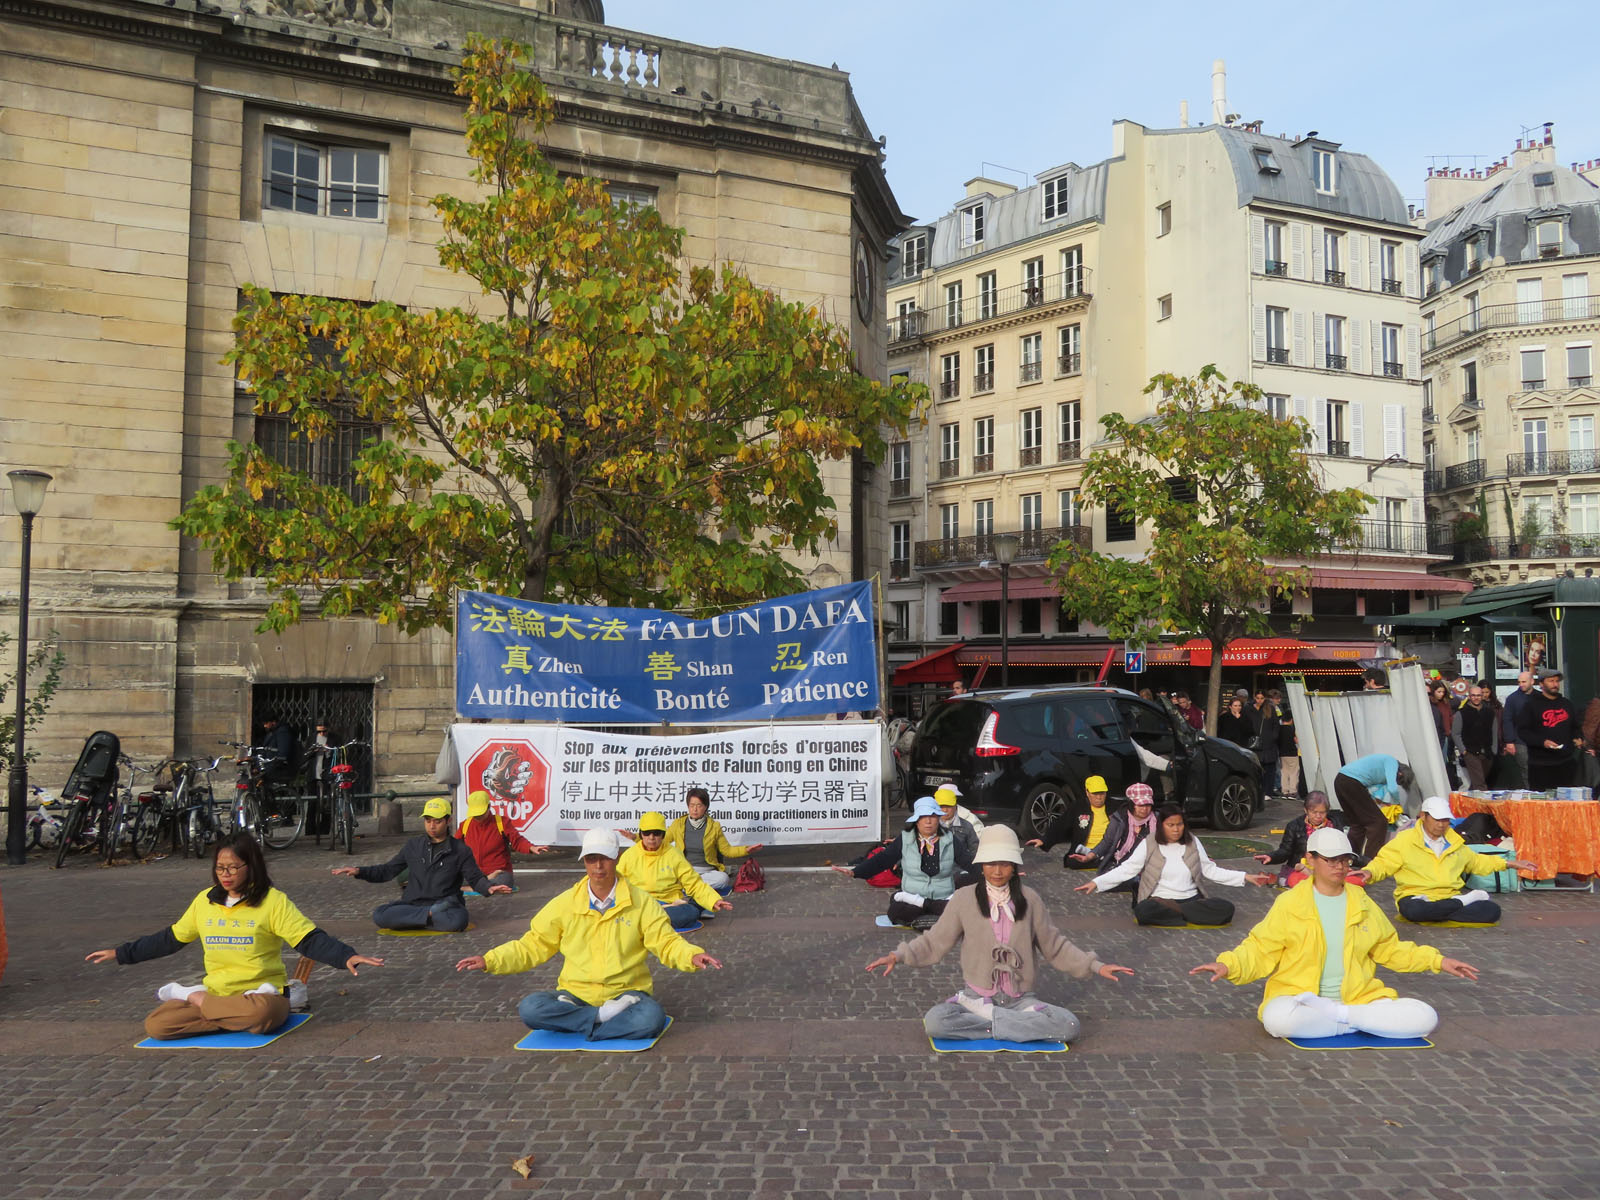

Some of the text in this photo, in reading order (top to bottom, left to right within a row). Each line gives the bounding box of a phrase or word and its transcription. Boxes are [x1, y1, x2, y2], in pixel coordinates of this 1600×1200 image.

[469, 603, 630, 641] 法輪大法
[639, 598, 868, 641] FALUN DAFA
[501, 644, 533, 675] 真
[538, 656, 584, 675] Zhen
[644, 651, 682, 681] 善
[770, 642, 808, 673] 忍
[812, 650, 848, 667] Ren
[1222, 652, 1268, 660] RASSERIE
[687, 661, 733, 678] Shan
[466, 682, 622, 710] Authenticité
[655, 686, 730, 711] Bonté
[762, 678, 869, 706] Patience
[564, 739, 868, 758] Stop aux prélèvements forcés d'organes
[562, 757, 868, 775] sur les pratiquants de Falun Gong en Chine
[560, 809, 581, 821] Stop
[583, 809, 601, 820] live
[604, 811, 632, 821] organ
[735, 809, 760, 821] Gong
[762, 809, 827, 821] practitioners
[830, 808, 839, 819] in
[841, 808, 869, 819] China
